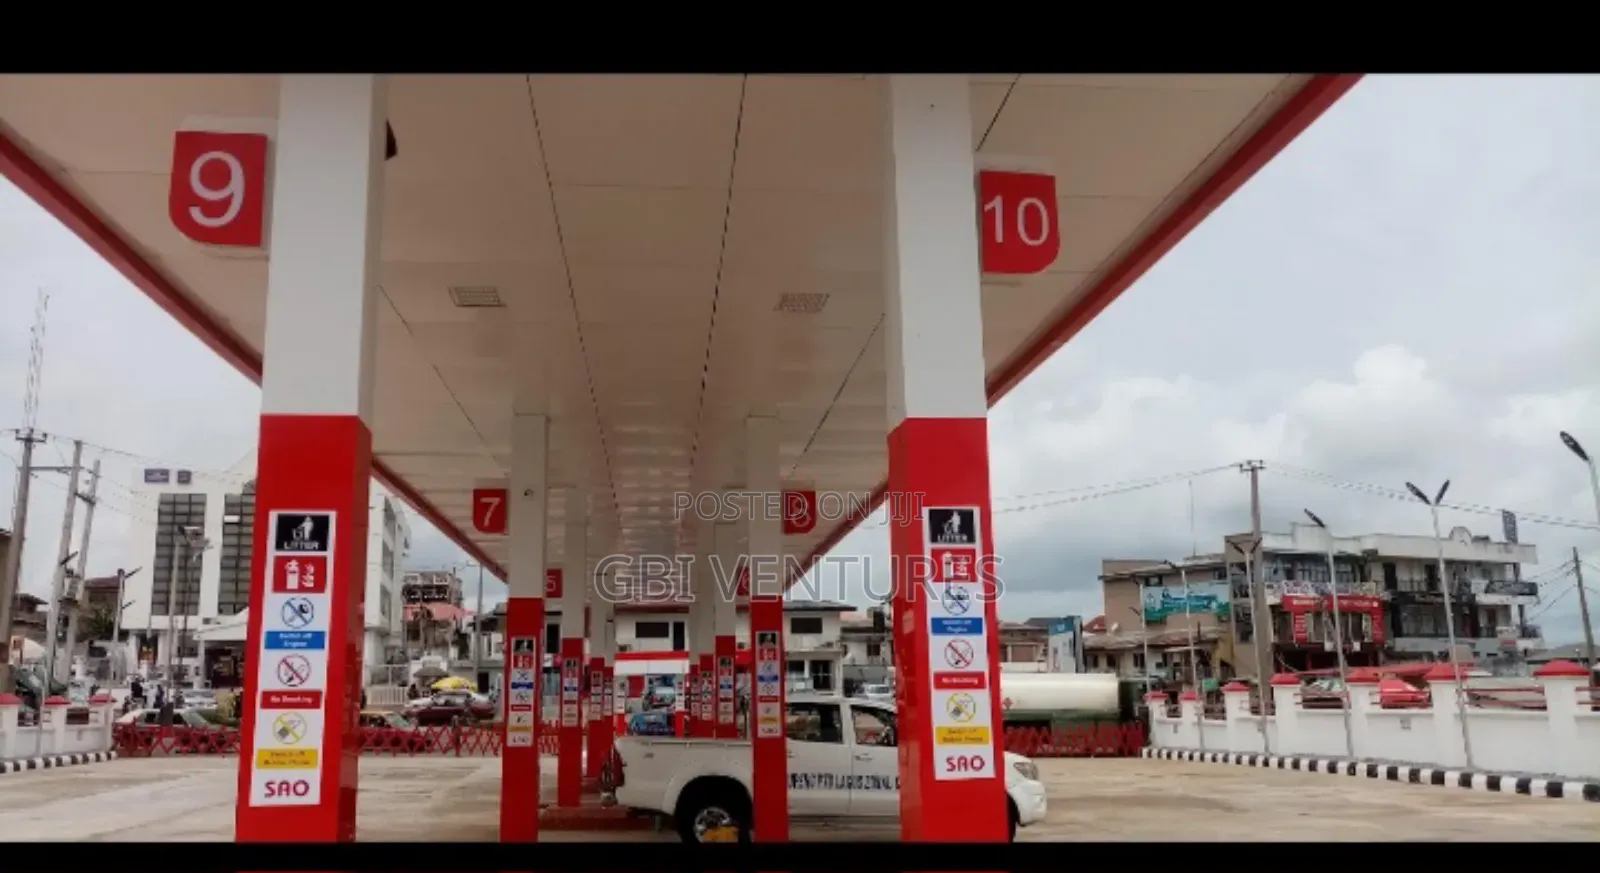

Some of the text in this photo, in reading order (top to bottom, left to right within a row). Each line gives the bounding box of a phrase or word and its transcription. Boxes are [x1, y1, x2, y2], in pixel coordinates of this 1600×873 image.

[188, 151, 244, 227] 9
[984, 193, 1049, 246] 10
[480, 497, 501, 527] 7
[946, 755, 986, 773] SAO
[264, 779, 310, 798] SAO
